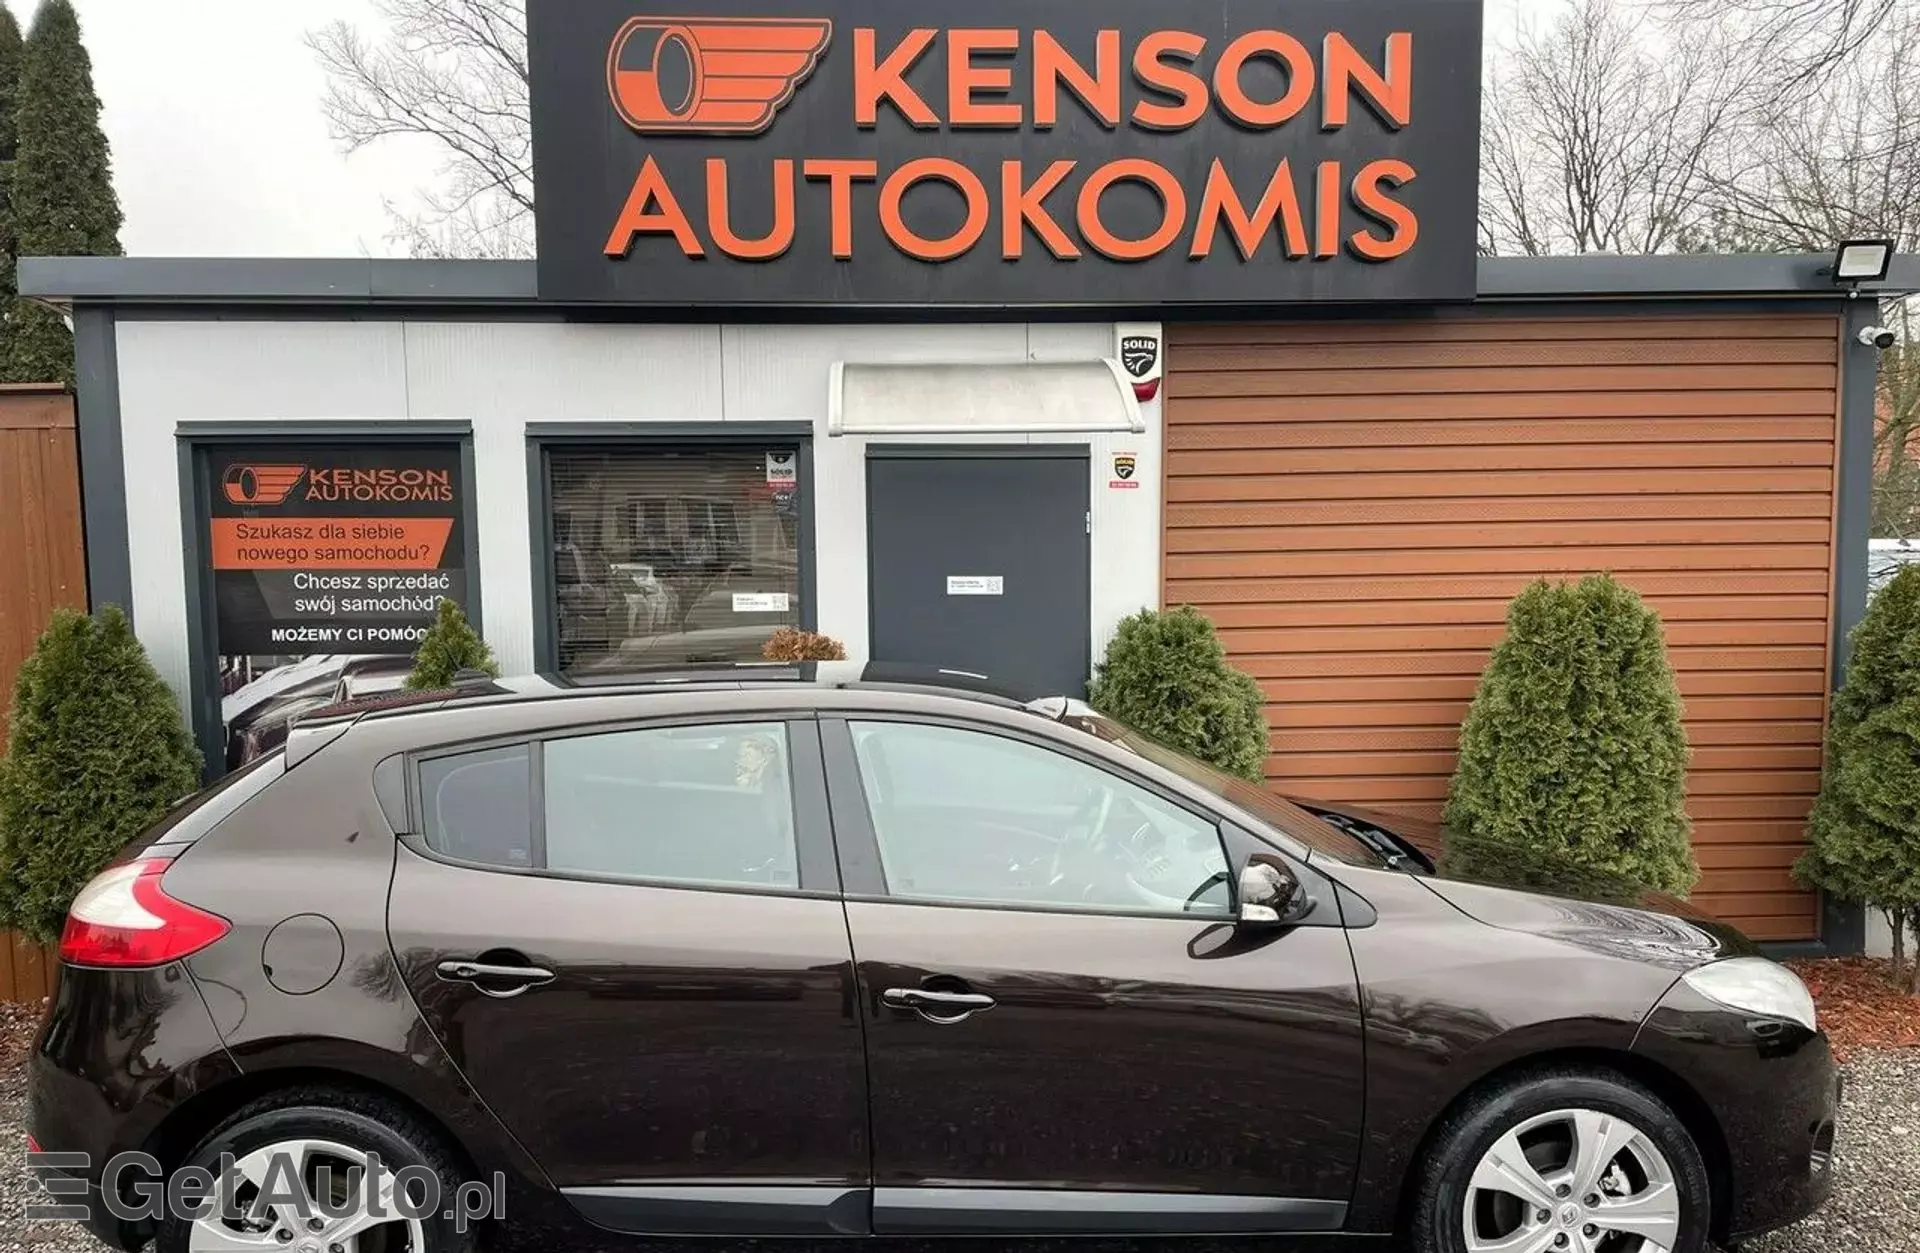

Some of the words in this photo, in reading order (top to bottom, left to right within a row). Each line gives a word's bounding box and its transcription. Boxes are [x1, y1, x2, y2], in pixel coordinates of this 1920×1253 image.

[852, 28, 1412, 130] KENSON
[603, 155, 1418, 262] AUTOKOMIS
[1123, 340, 1156, 350] SOLID
[310, 469, 449, 485] KENSON
[304, 485, 453, 501] AUTOKOMIS
[236, 523, 313, 540] Szukasz
[319, 523, 346, 540] dla
[352, 523, 405, 540] siebie
[237, 546, 309, 564] nowego
[315, 544, 430, 561] samochodu?
[293, 573, 362, 590] Chcesz
[367, 573, 450, 593] sprzedać
[295, 595, 336, 615] swój
[271, 627, 343, 642] MOŻEMY
[346, 629, 363, 641] CI
